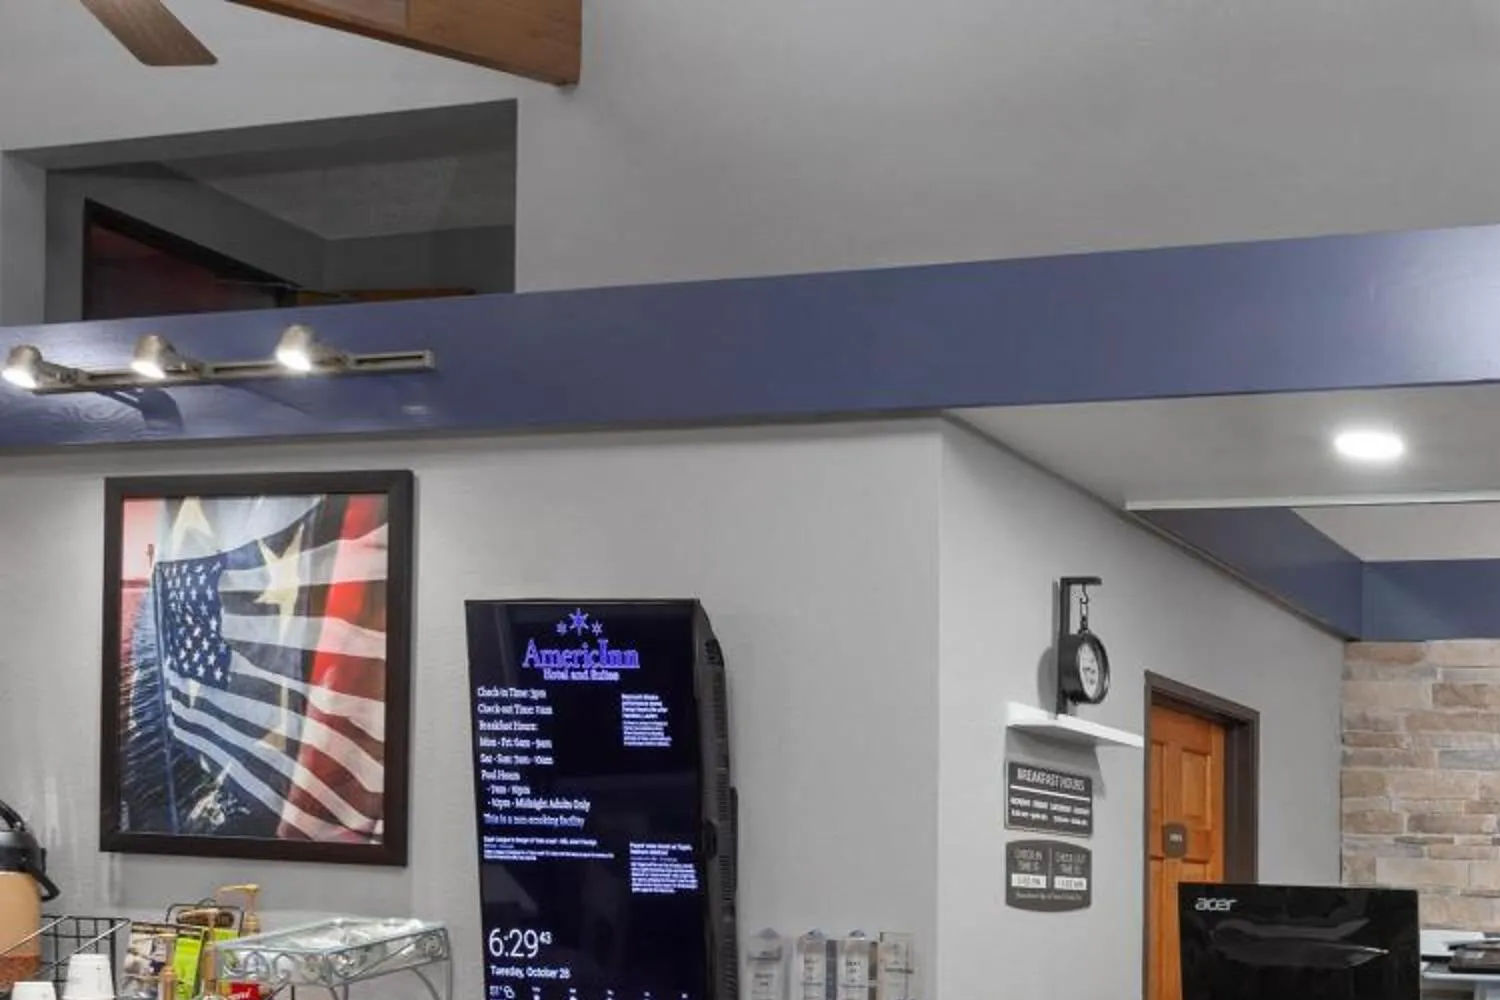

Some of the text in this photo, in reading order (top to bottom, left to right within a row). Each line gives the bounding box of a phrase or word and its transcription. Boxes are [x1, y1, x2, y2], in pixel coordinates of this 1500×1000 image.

[522, 637, 641, 669] AmericInn
[543, 668, 569, 680] Hotel
[571, 669, 589, 681] and
[482, 769, 496, 780] Pool
[1016, 767, 1059, 787] BREAKFAST
[573, 799, 591, 813] Only
[1195, 897, 1237, 911] acer
[489, 928, 539, 958] 6:29
[490, 965, 525, 979] Tuesday,
[526, 966, 559, 979] October
